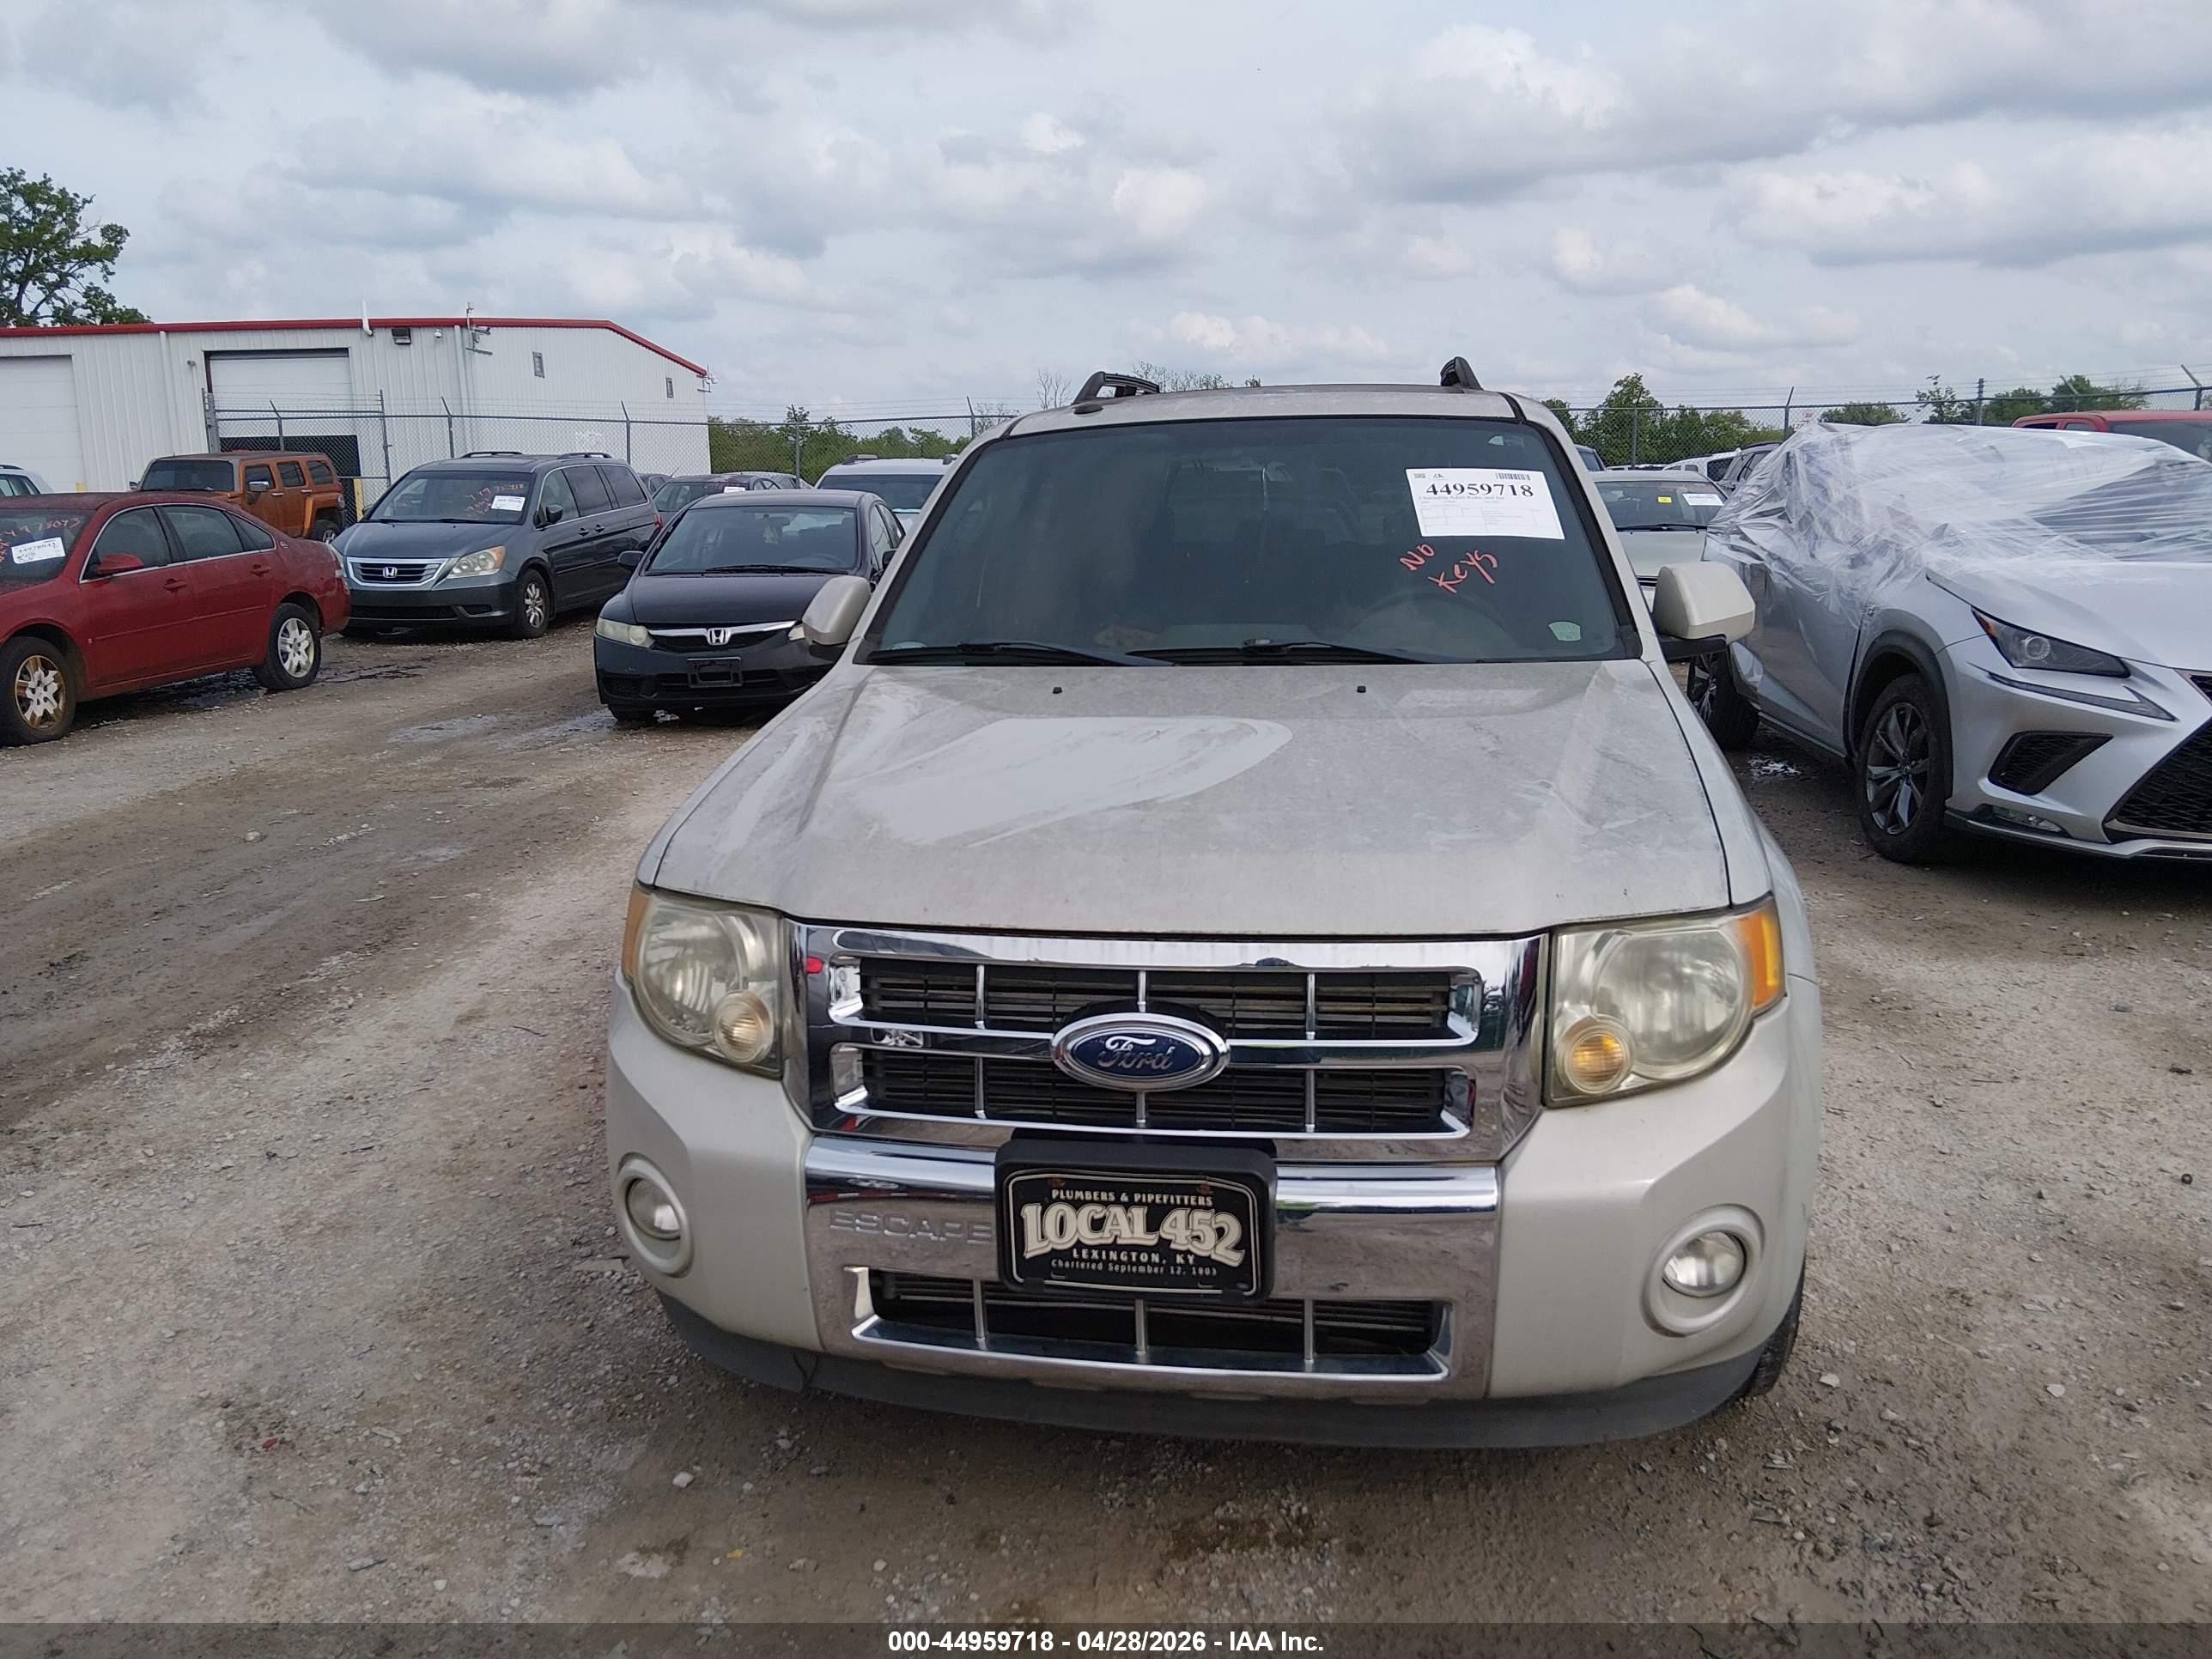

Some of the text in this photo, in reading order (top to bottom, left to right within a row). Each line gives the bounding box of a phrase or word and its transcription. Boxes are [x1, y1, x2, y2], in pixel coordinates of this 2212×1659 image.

[1425, 483, 1534, 497] 44959718
[1400, 544, 1435, 570] No
[1427, 550, 1498, 593] Keys
[1097, 1036, 1176, 1070] Ford
[1051, 1188, 1212, 1207] PLUMBERS & PIPEFITTERS
[830, 1209, 992, 1244] ESCAPE
[1020, 1202, 1245, 1267] LOCAL 452
[1051, 1258, 1103, 1271] Chartered
[1108, 1262, 1164, 1275] September
[1176, 1253, 1195, 1265] KY
